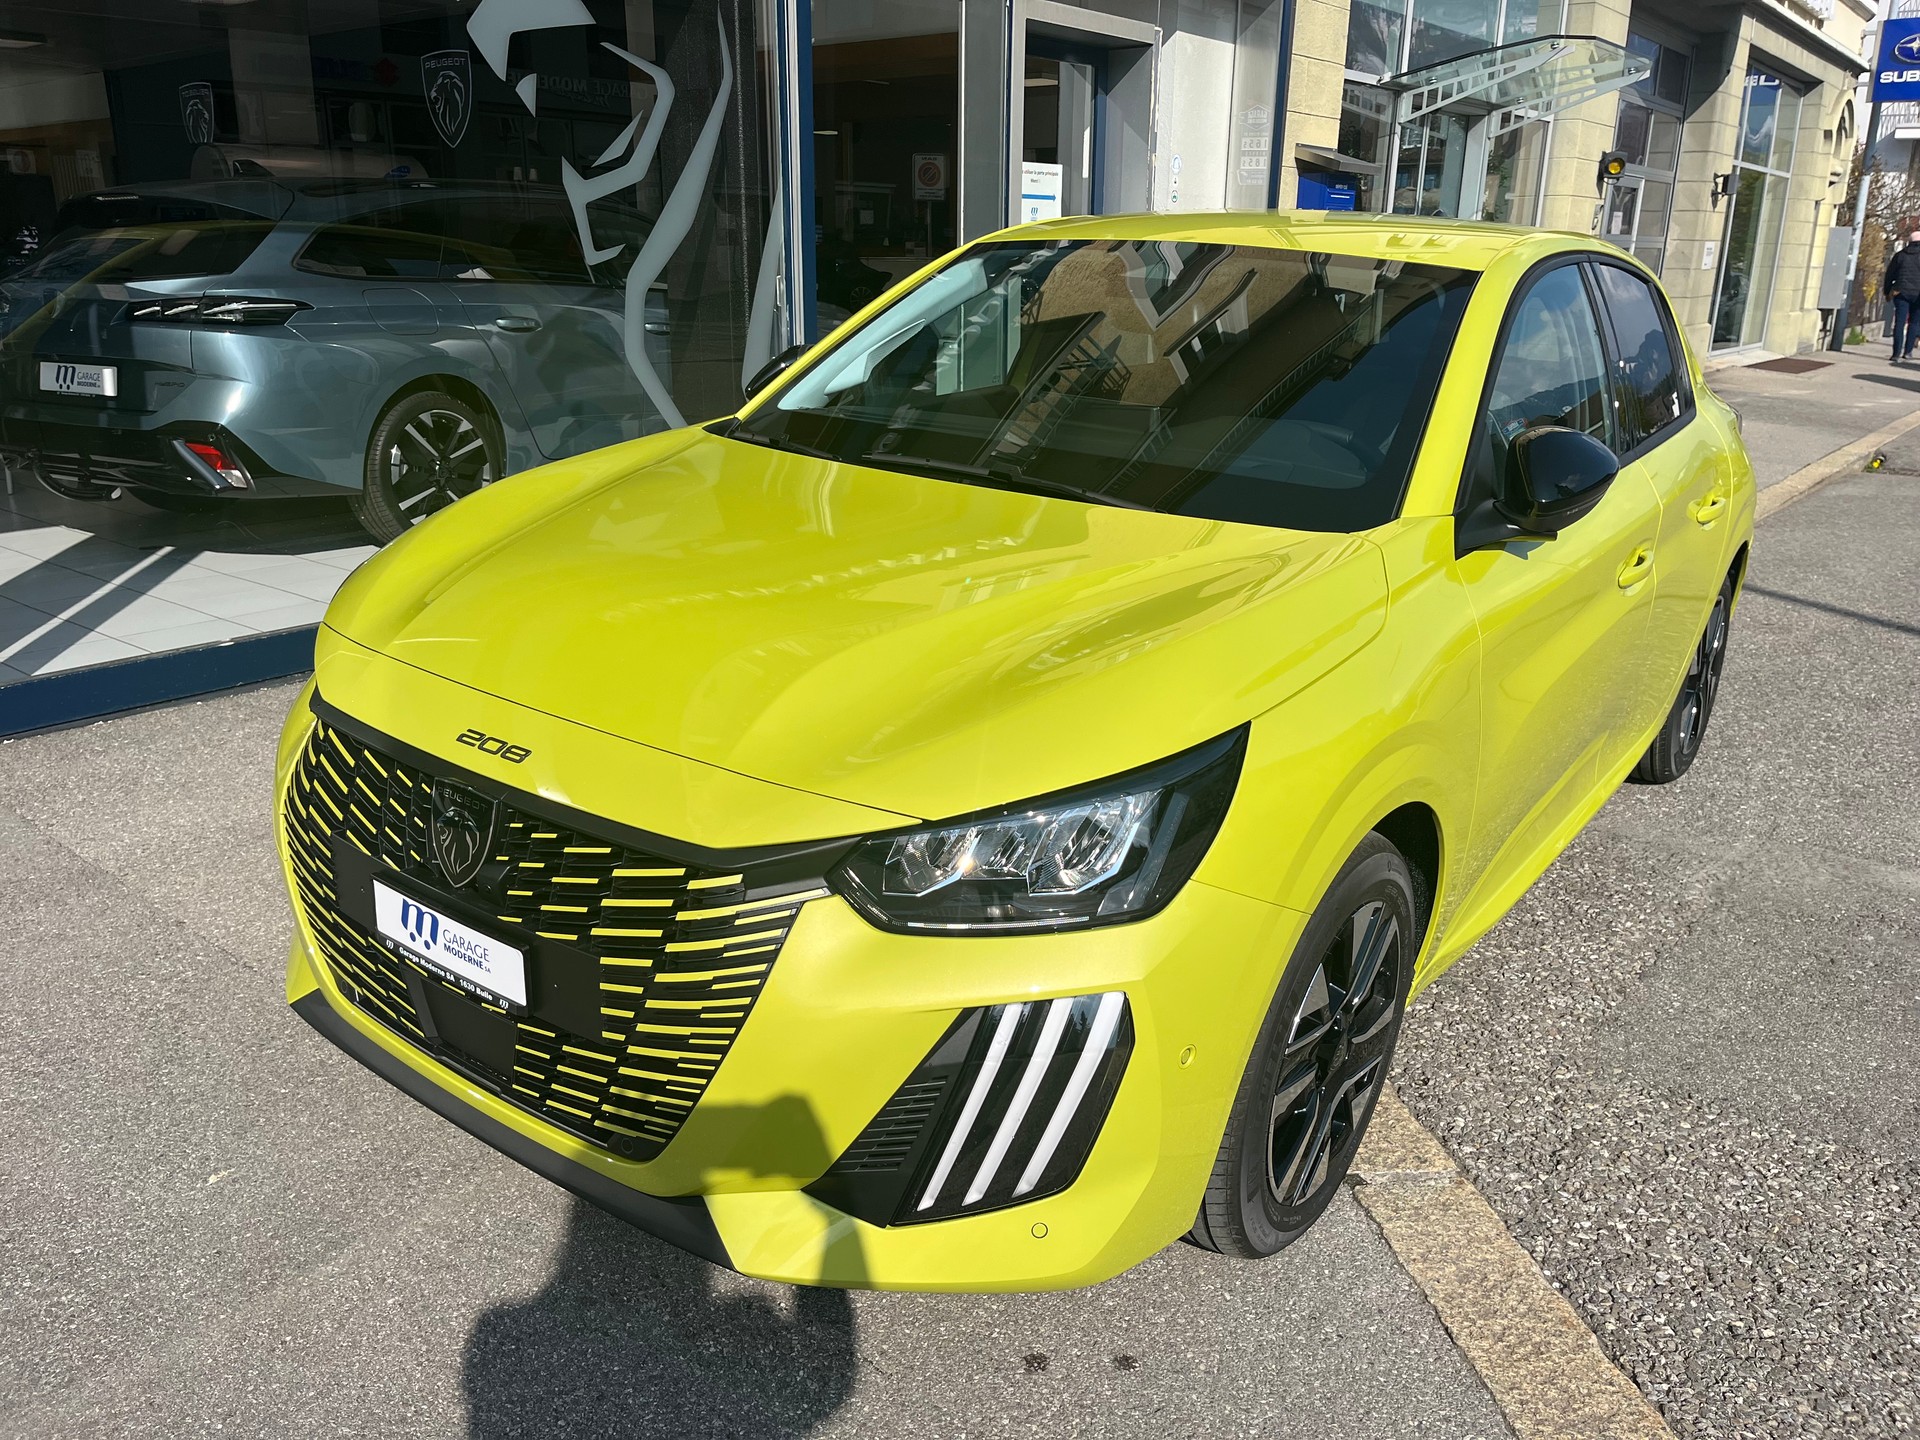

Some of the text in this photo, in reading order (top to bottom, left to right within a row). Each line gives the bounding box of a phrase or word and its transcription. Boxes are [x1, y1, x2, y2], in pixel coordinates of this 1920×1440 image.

[425, 58, 466, 69] PEUGEOT
[1879, 70, 1920, 84] SUB
[77, 371, 101, 382] GARAGE
[456, 728, 533, 764] 208
[438, 786, 488, 812] PEUGEOT
[442, 929, 490, 962] GARAGE
[443, 942, 484, 970] MODERNE
[399, 946, 420, 964] Garage
[420, 956, 445, 977] Moderne
[446, 970, 455, 982] SA
[459, 979, 475, 992] 1630
[476, 987, 493, 1001] Bulle
